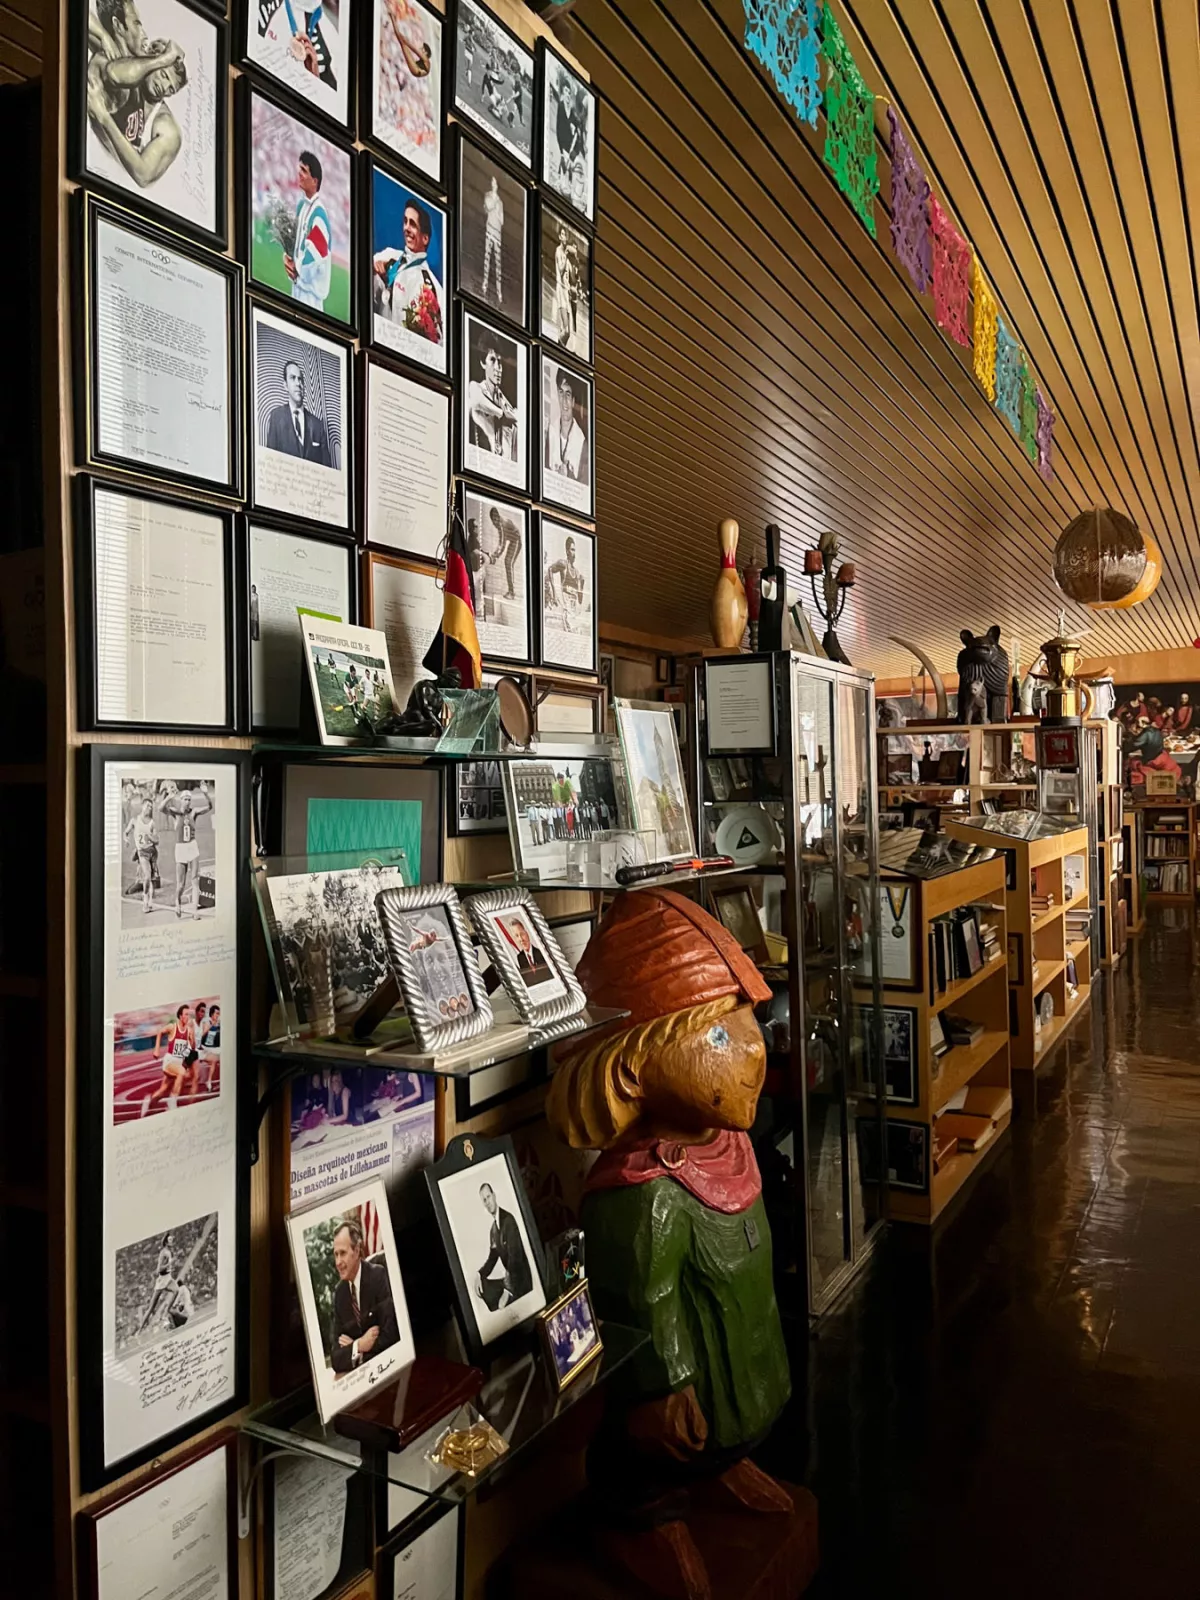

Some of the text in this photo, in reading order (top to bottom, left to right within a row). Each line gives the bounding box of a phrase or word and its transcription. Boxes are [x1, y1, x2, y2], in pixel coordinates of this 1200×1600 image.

[291, 1166, 316, 1184] Diseña
[318, 1152, 355, 1173] arquitecto
[356, 1140, 388, 1157] mexicano
[304, 1174, 338, 1194] mascotas
[339, 1168, 349, 1181] de
[349, 1154, 391, 1175] Lillehammer
